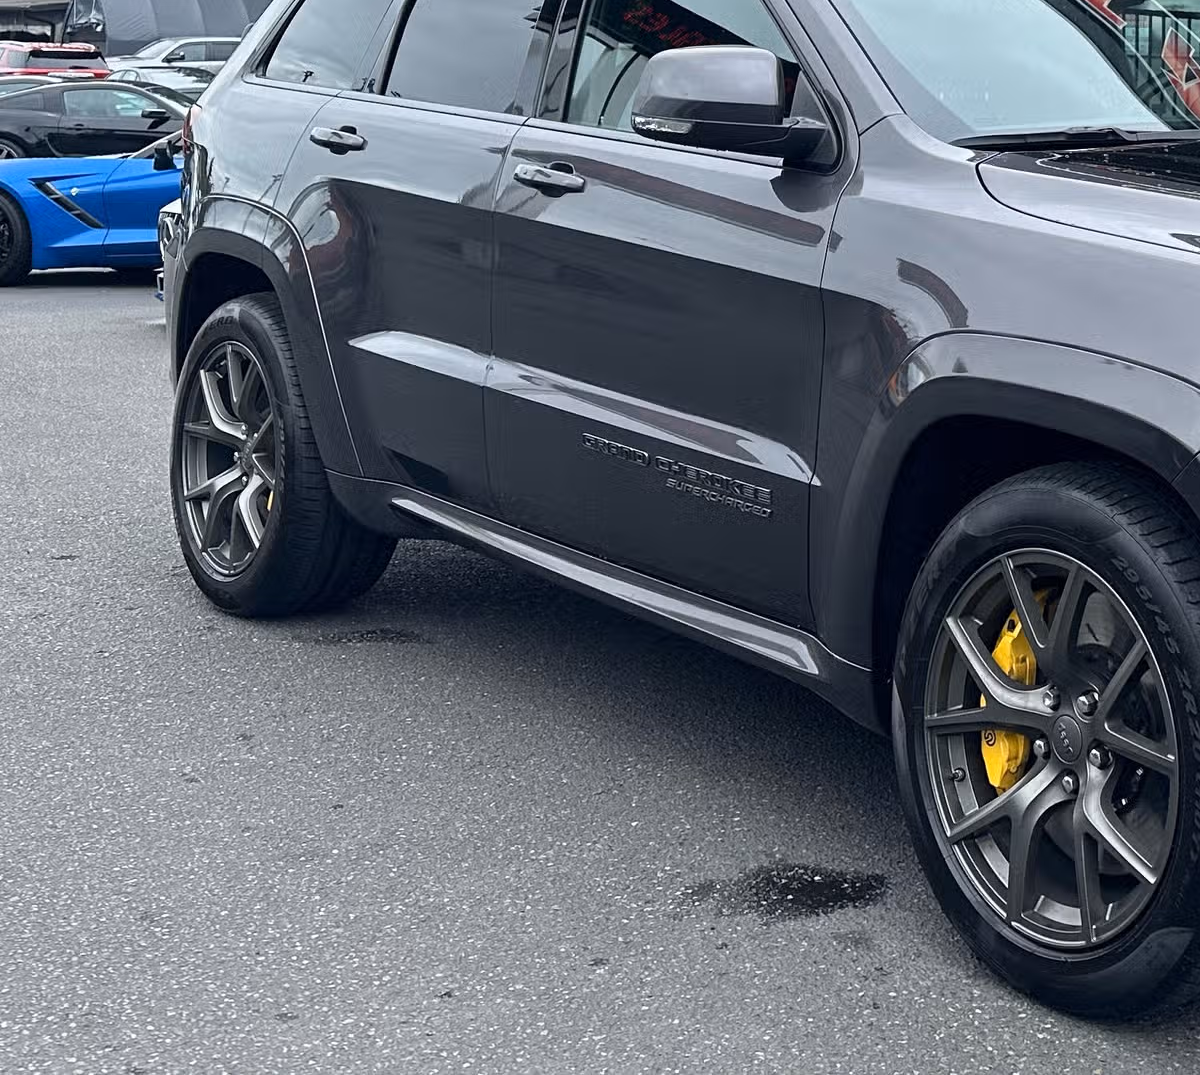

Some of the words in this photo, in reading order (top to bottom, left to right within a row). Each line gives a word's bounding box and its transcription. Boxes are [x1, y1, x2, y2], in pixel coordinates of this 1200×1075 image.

[582, 432, 650, 468] GRAND
[655, 455, 773, 505] CHEROKEE
[666, 477, 773, 518] SUPERCHARGED
